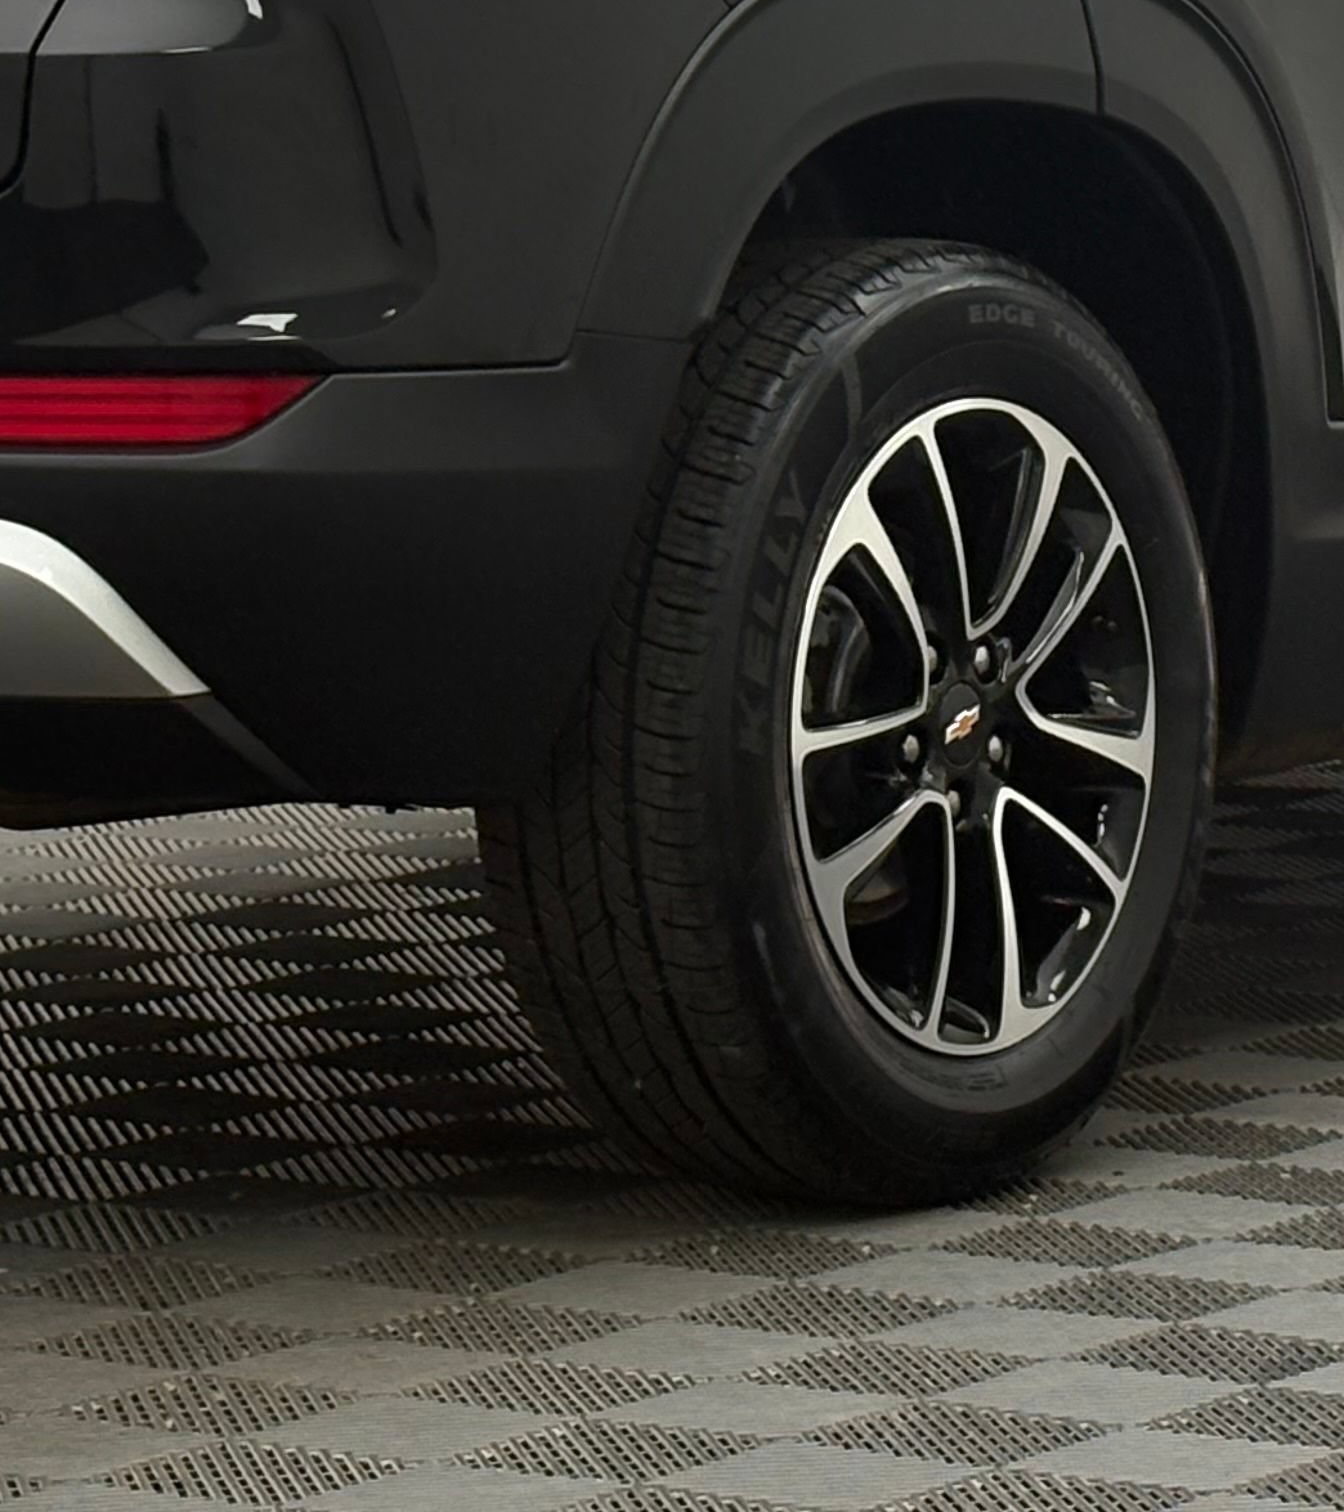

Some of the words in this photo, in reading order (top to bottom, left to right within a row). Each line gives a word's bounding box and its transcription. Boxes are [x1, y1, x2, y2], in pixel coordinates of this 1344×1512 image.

[968, 303, 1036, 329] EDGE
[1050, 320, 1146, 423] TOURING
[737, 468, 807, 752] KELLY
